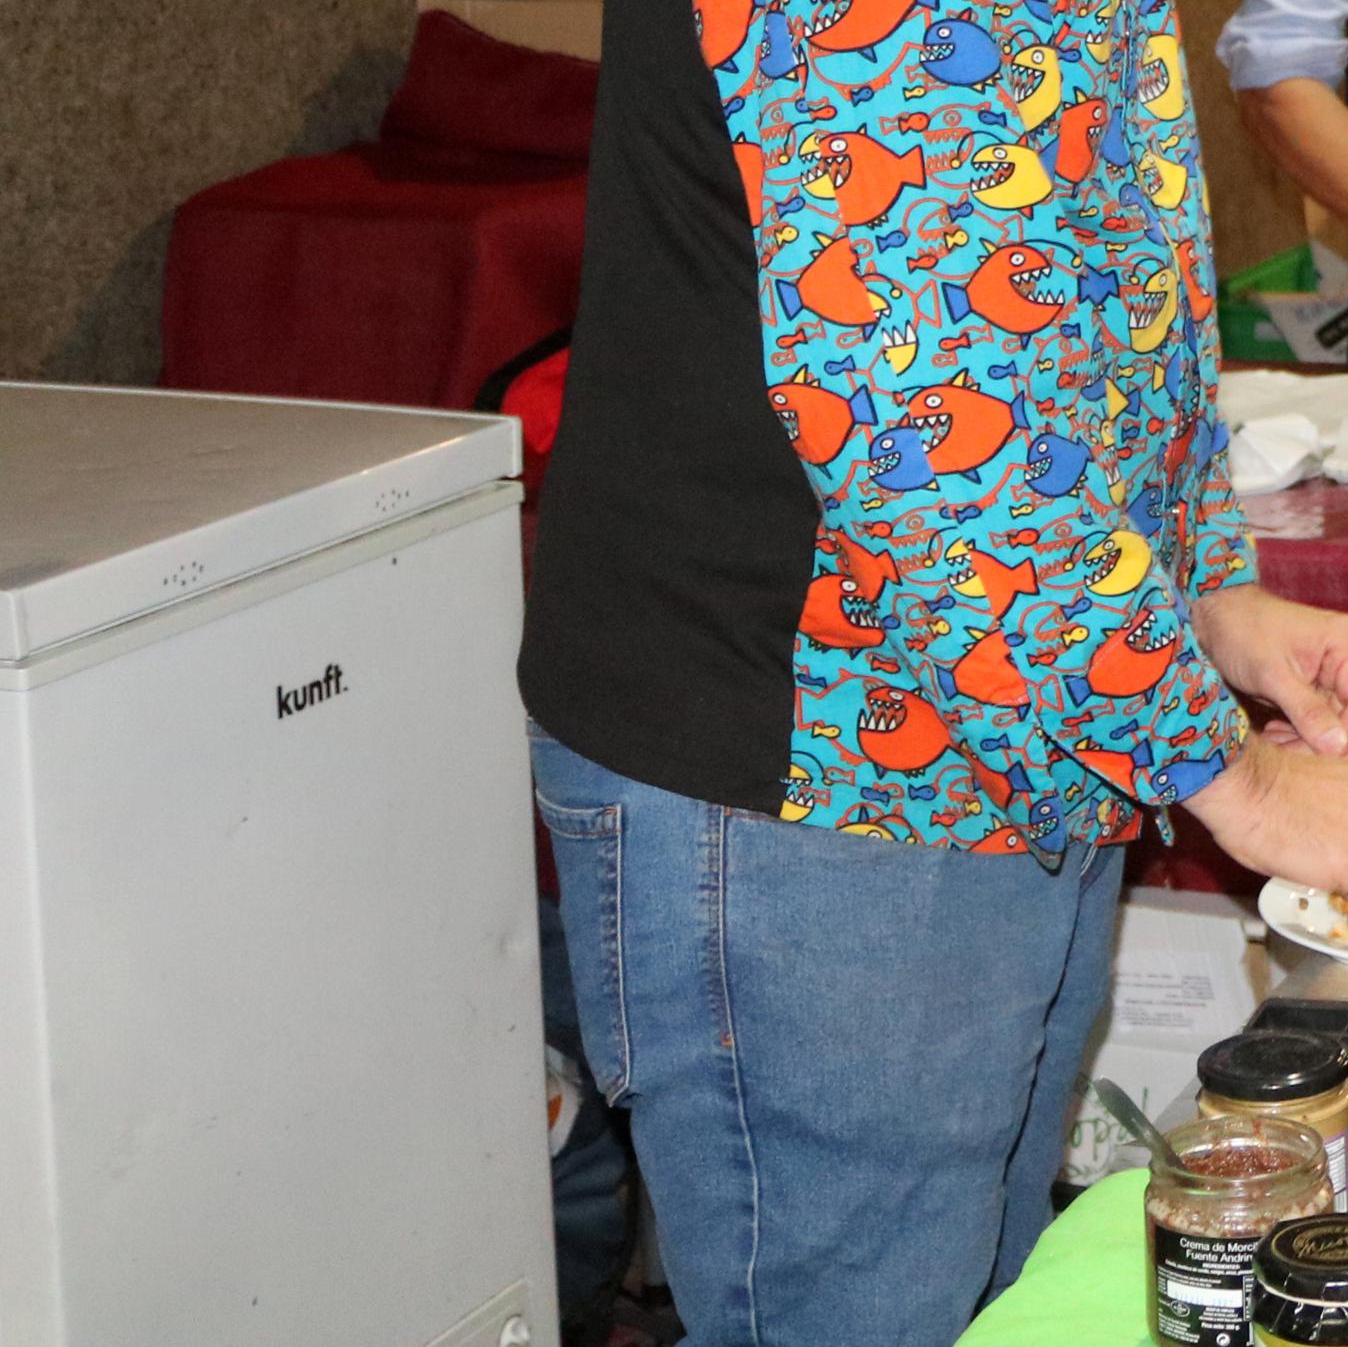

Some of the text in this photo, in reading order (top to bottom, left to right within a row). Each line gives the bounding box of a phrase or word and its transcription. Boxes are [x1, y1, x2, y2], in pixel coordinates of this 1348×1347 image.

[1180, 1237, 1210, 1253] Crema
[1212, 1242, 1226, 1253] de
[1186, 1249, 1219, 1262] Fuente
